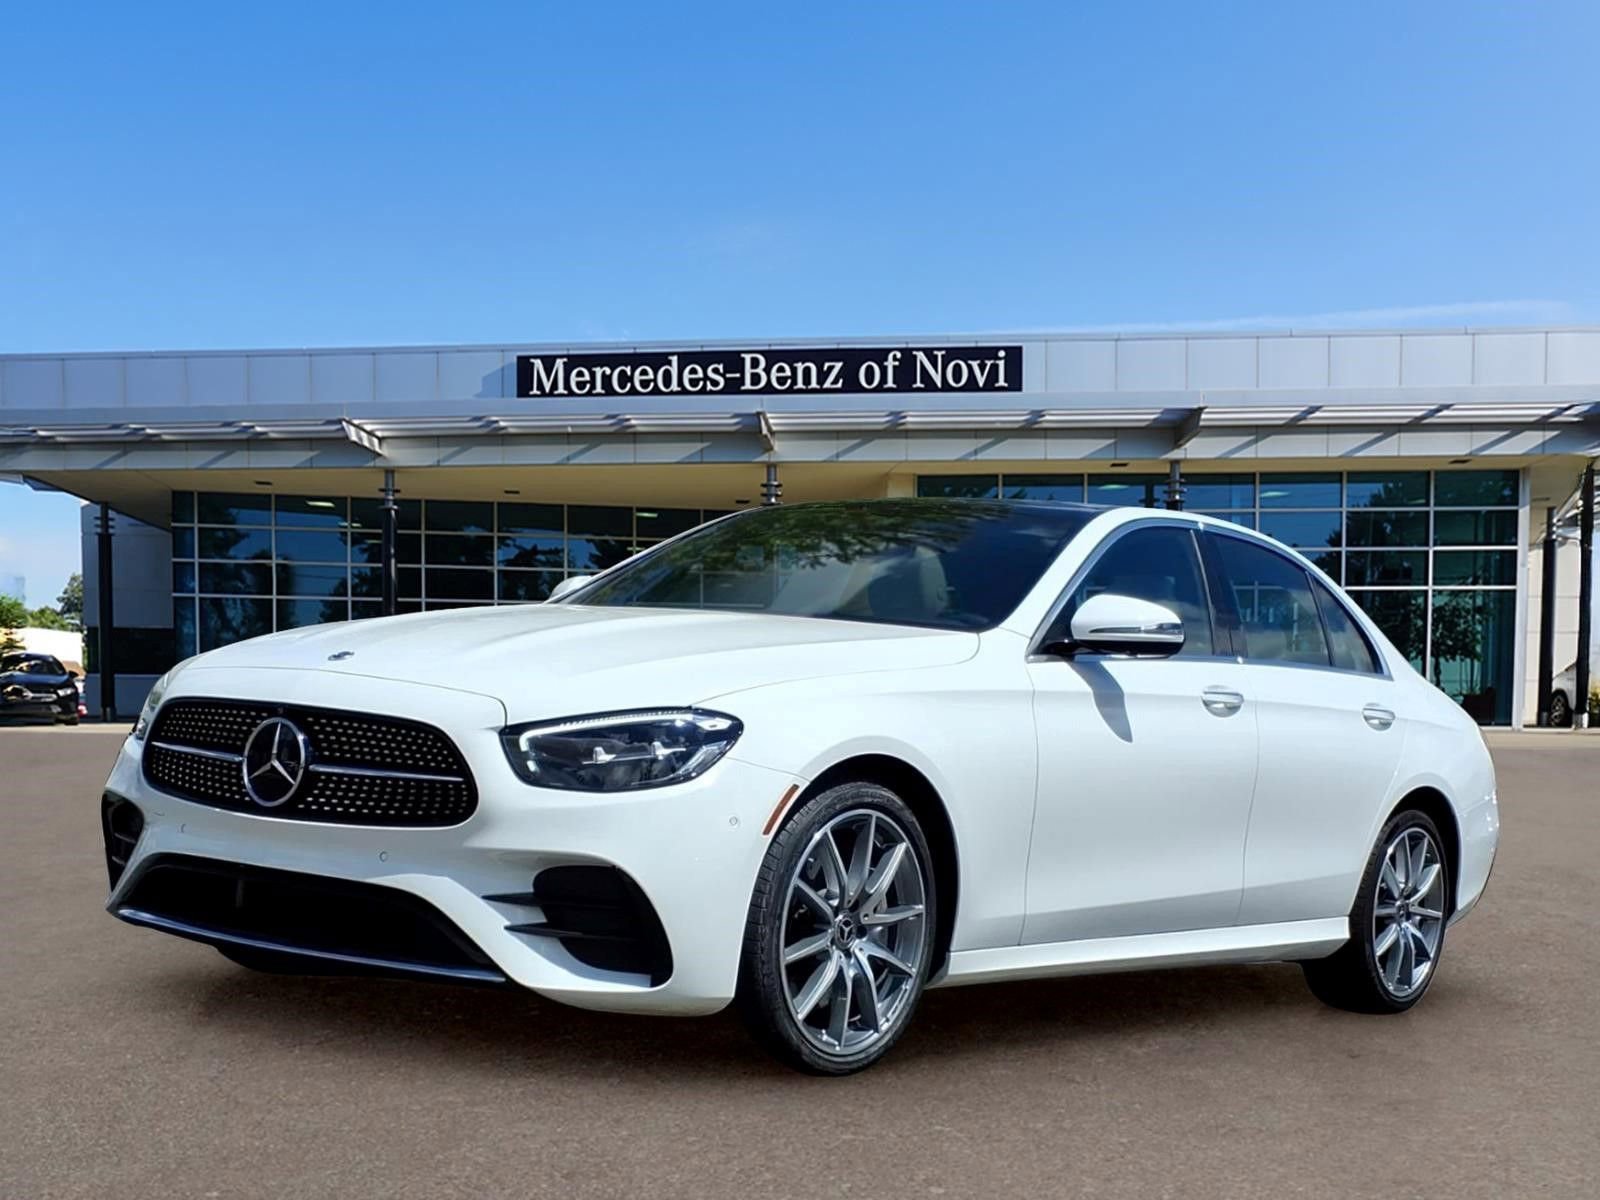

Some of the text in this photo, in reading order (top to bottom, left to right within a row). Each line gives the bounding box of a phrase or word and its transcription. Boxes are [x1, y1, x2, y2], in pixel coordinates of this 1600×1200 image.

[529, 350, 1009, 395] Mercedes-Benz of Novi
